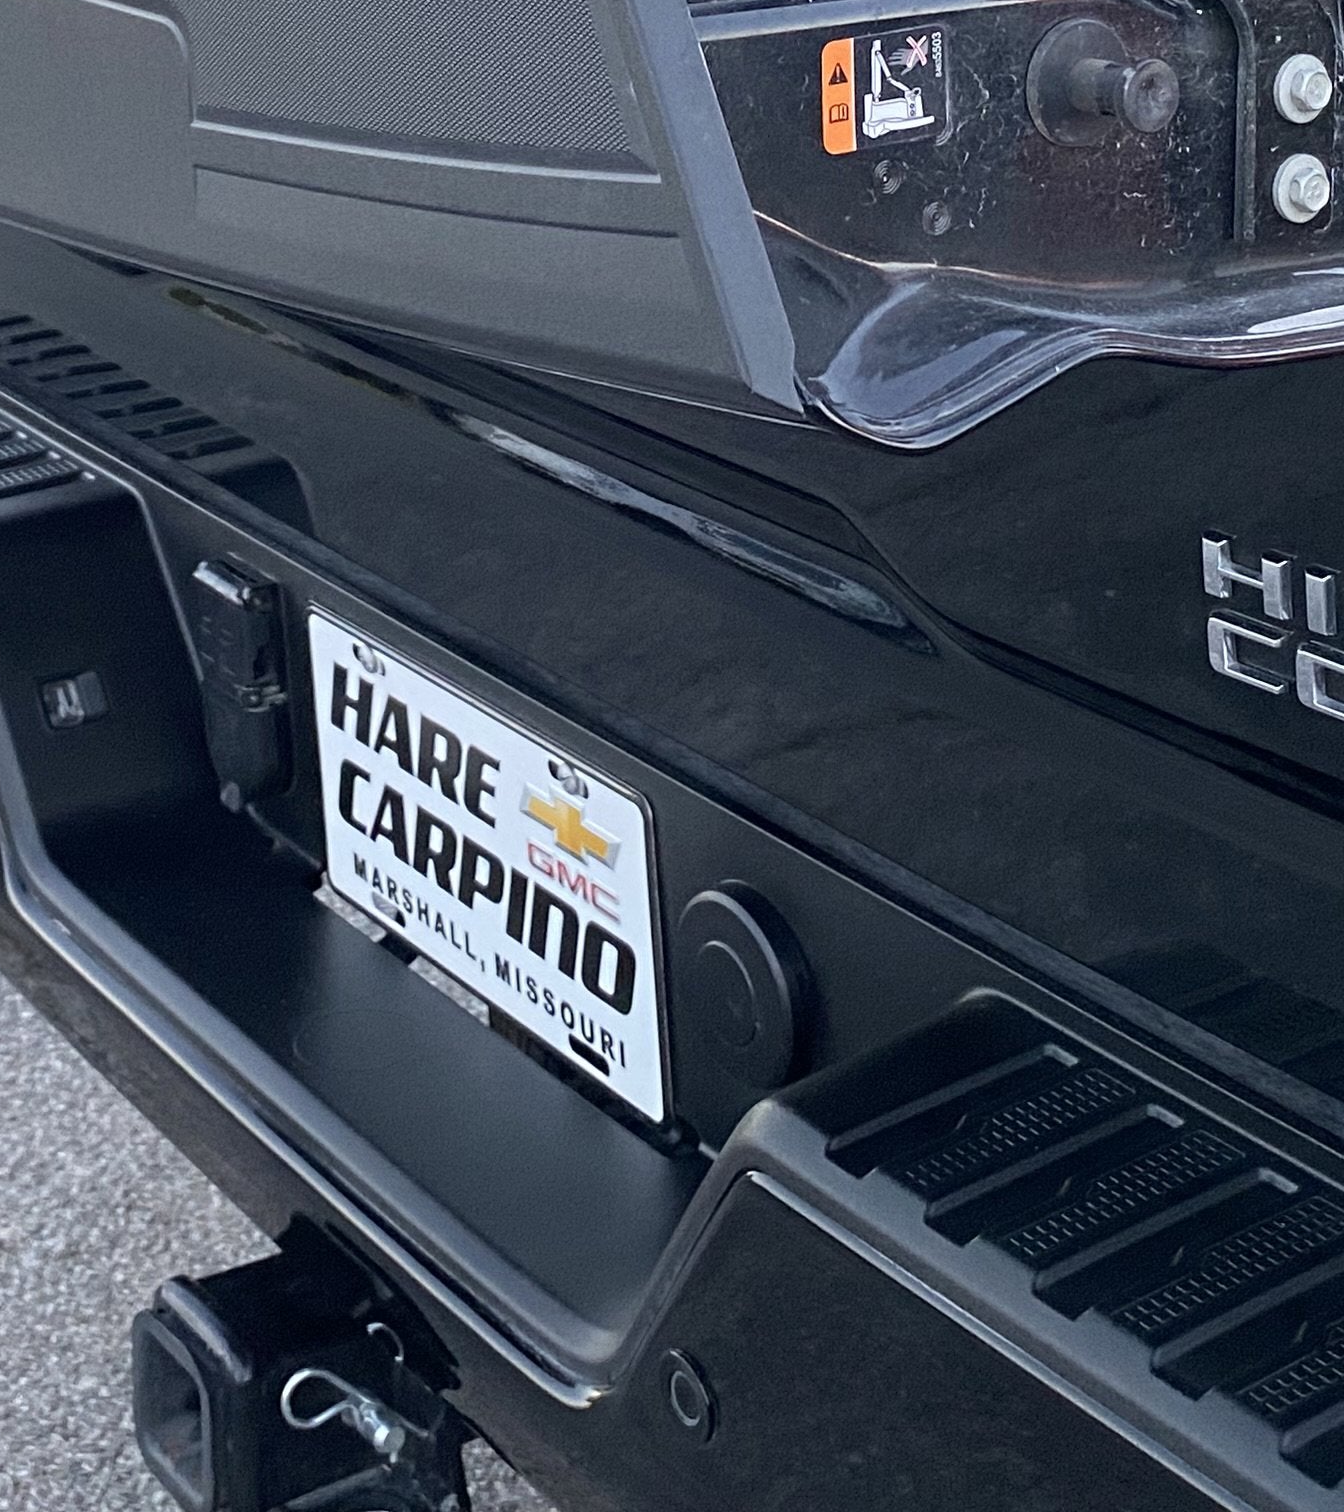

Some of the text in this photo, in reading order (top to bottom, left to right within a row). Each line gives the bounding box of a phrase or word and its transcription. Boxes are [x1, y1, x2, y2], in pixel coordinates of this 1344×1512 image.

[331, 661, 501, 829] HARE
[338, 758, 636, 1016] CARPINO
[353, 852, 627, 1069] MARSHALL, MISSOURI
[527, 841, 622, 924] GMC
